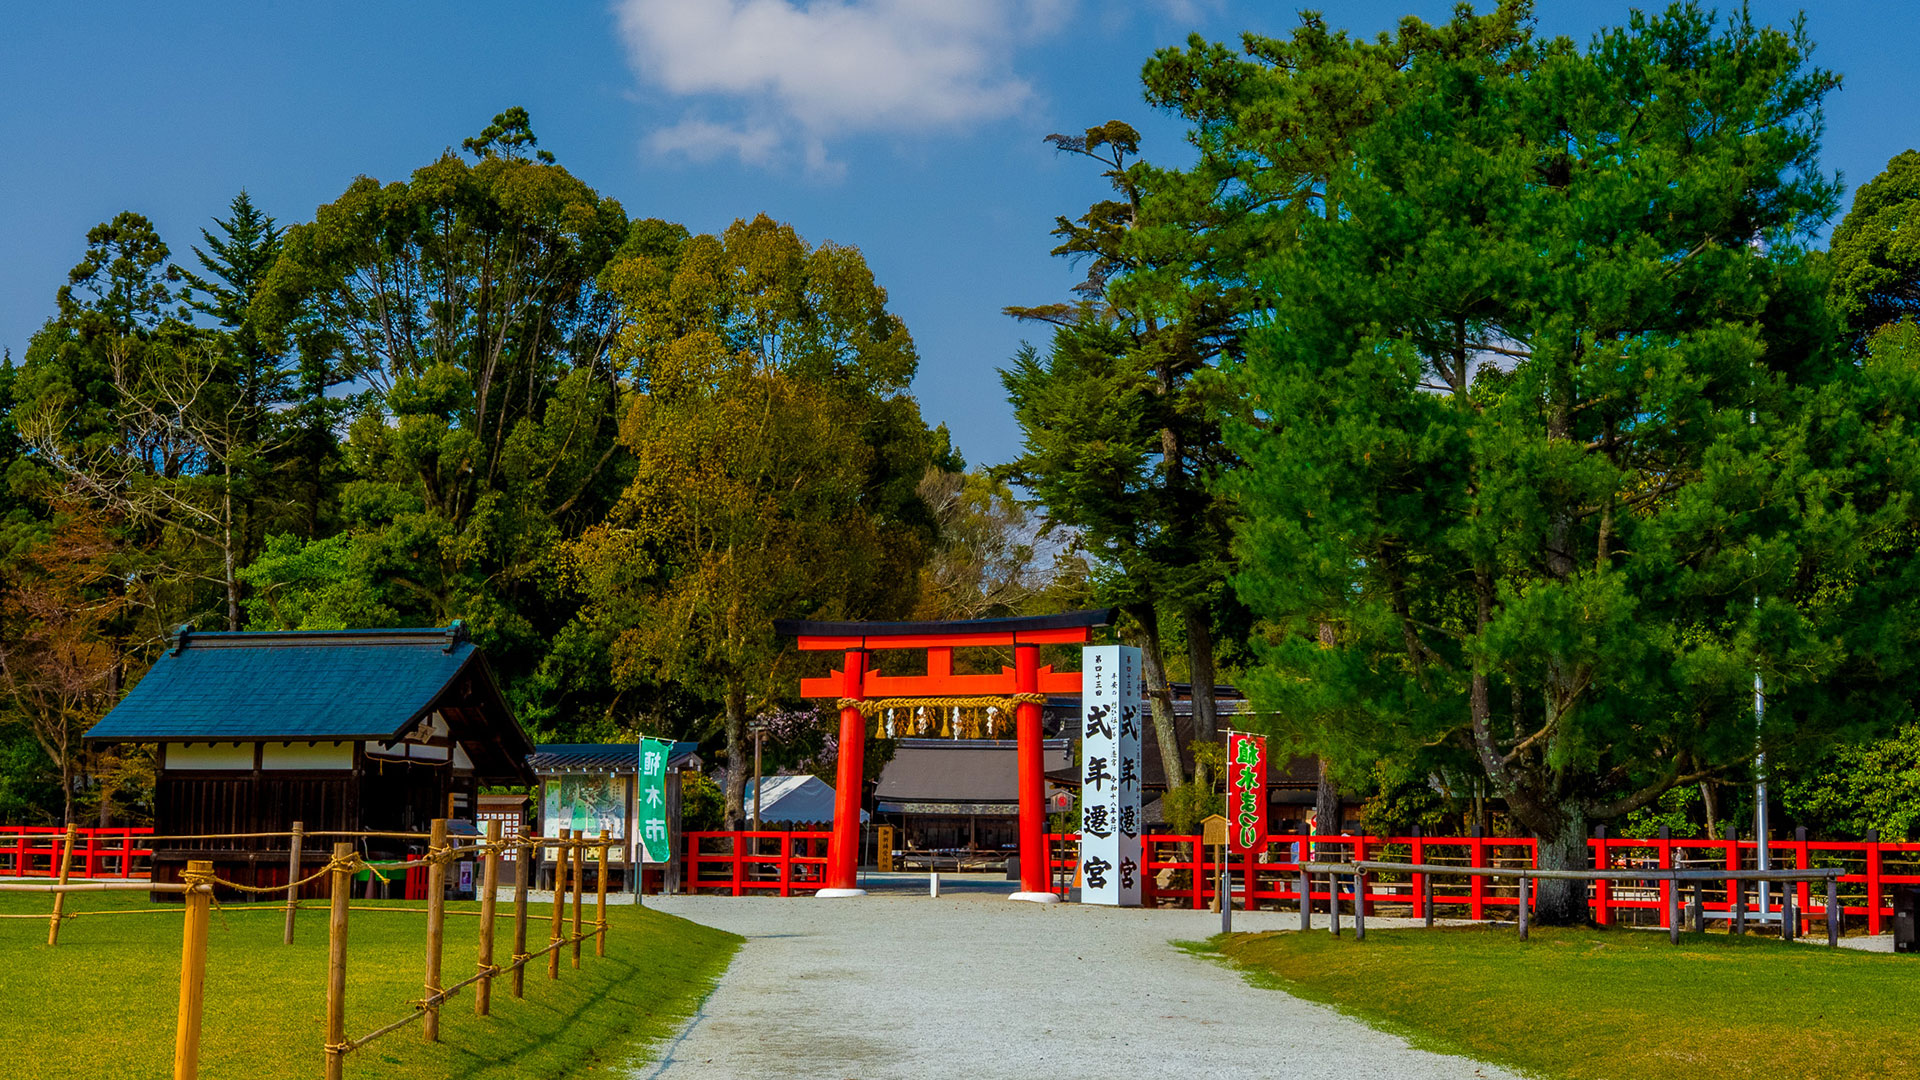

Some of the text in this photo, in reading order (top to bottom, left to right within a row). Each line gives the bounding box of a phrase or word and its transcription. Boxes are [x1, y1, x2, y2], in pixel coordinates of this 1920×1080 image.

[1084, 704, 1112, 889] 式年遷宮
[1120, 705, 1138, 889] 式年遷宮
